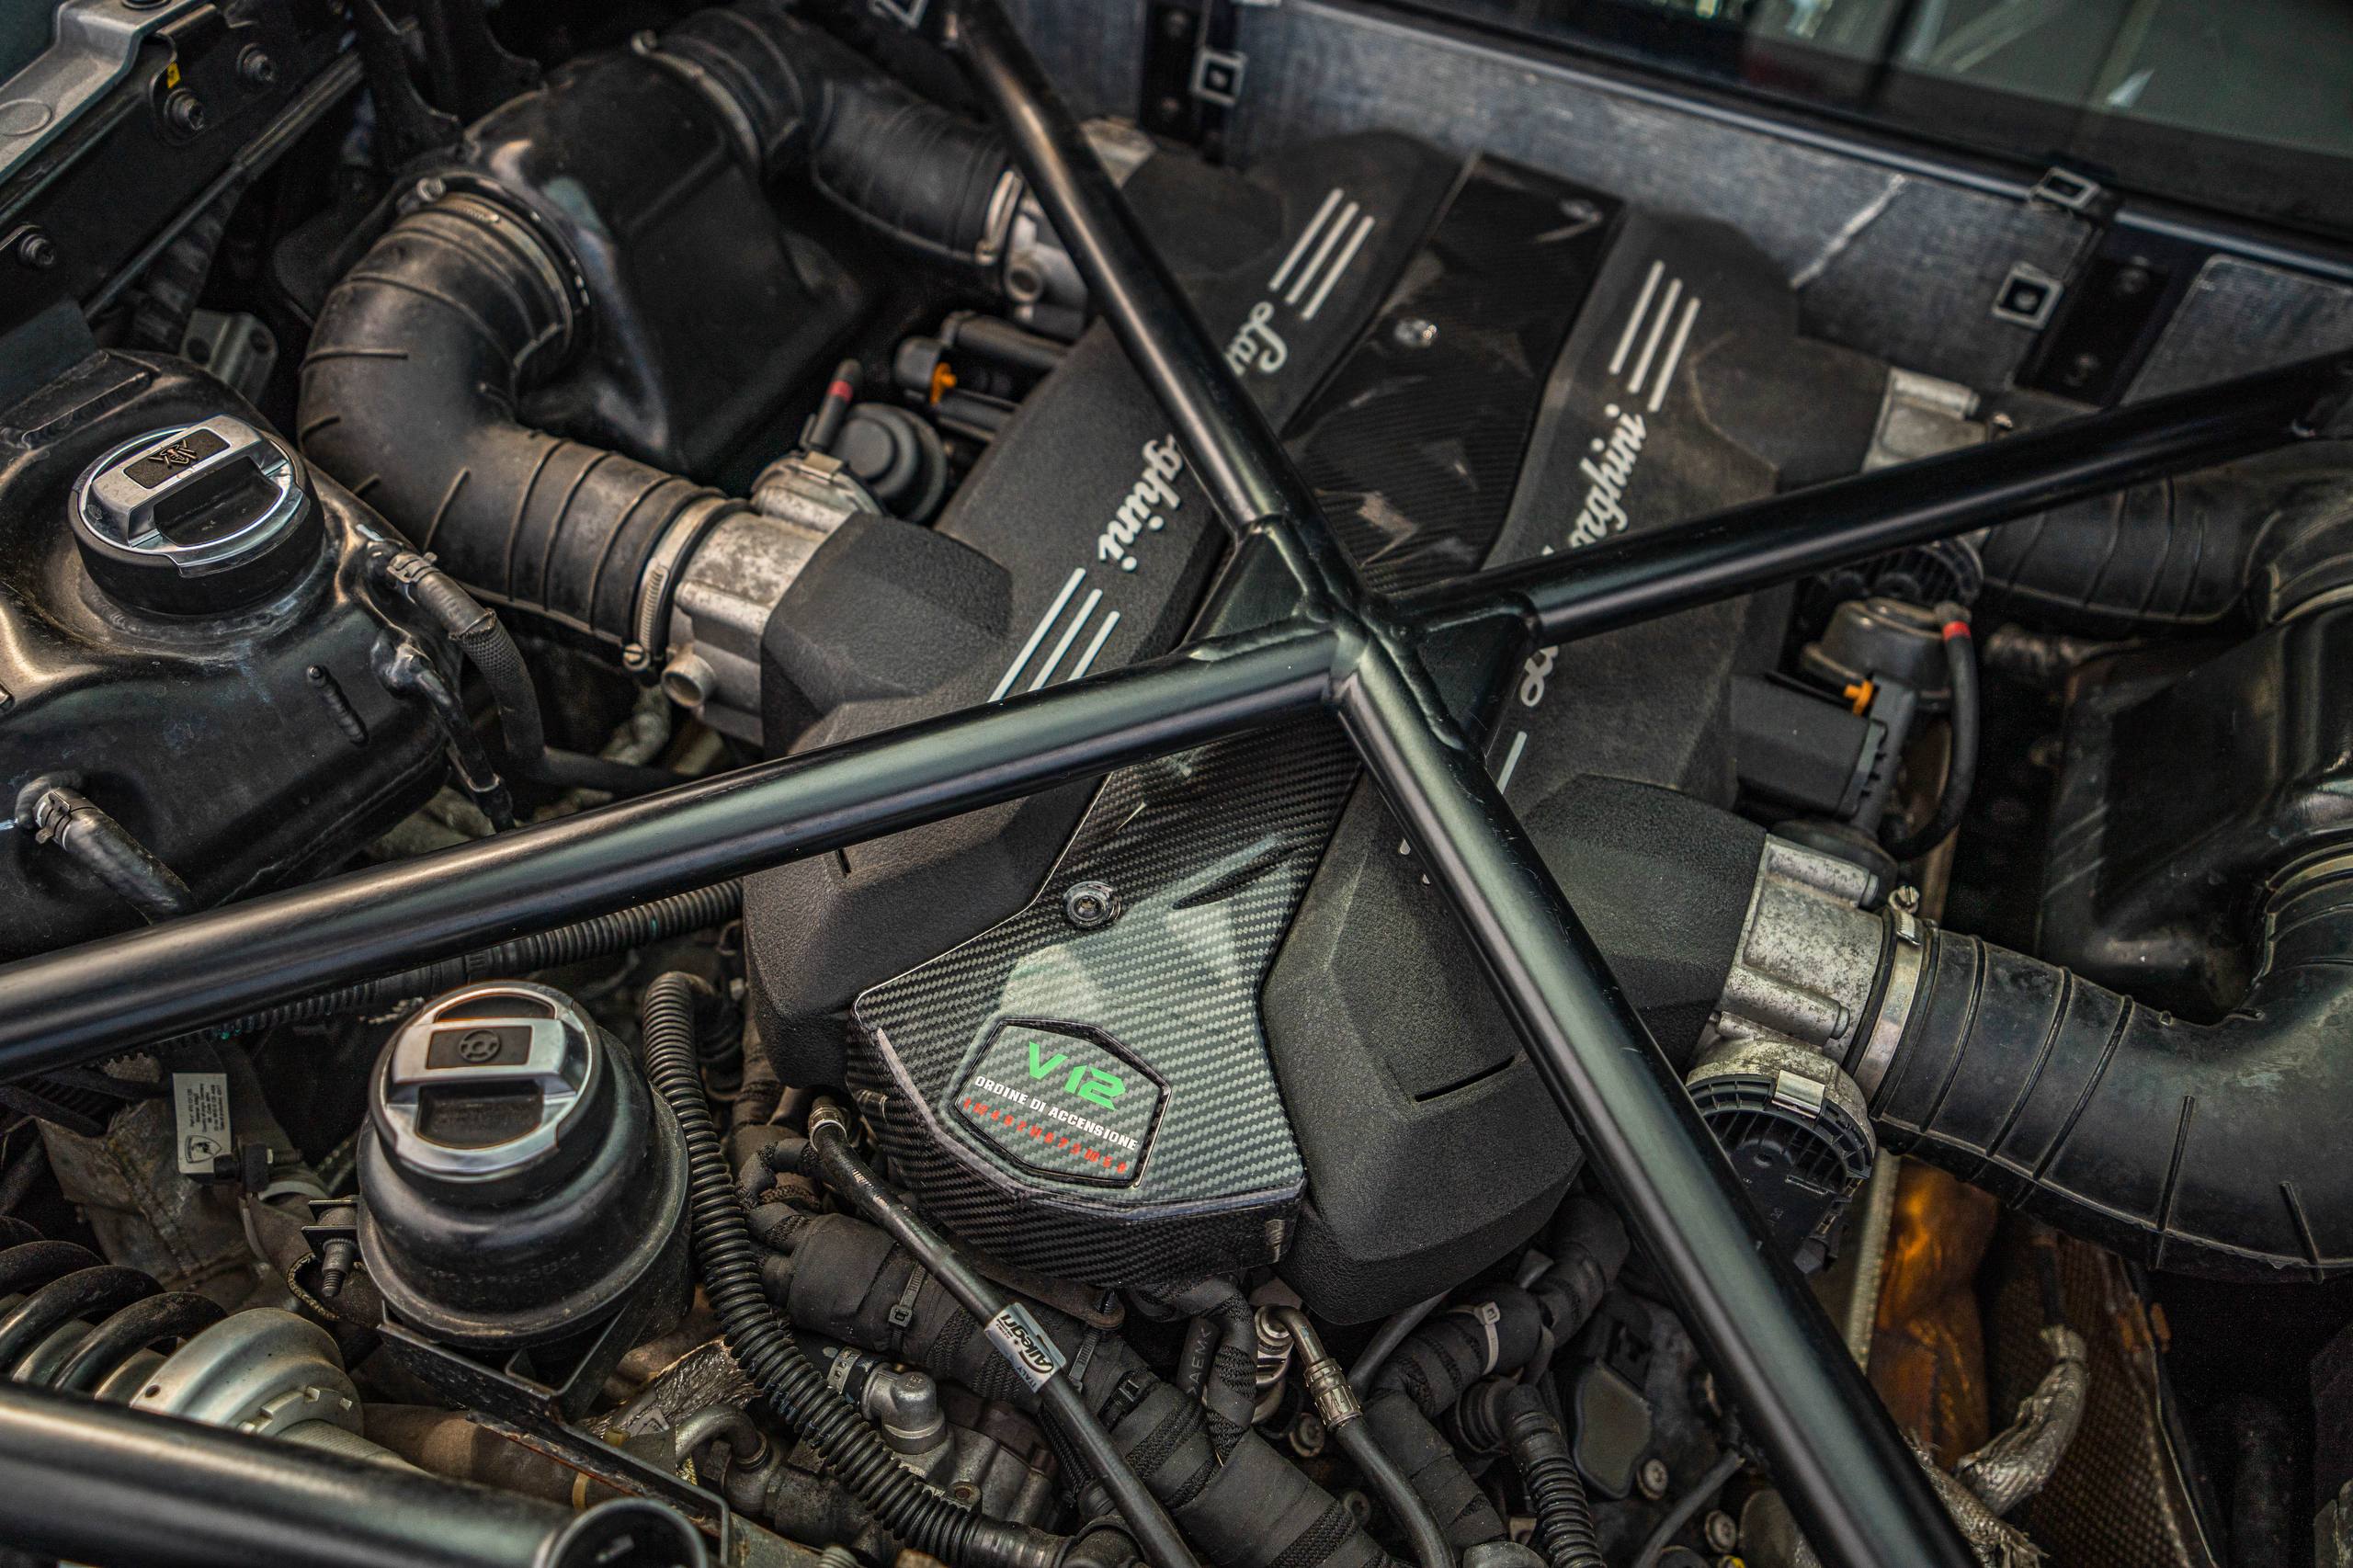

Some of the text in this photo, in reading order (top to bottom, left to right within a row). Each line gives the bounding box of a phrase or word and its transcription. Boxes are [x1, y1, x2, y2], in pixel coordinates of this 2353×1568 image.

[1029, 1041, 1126, 1111] V12
[974, 1075, 1139, 1151] ORDINE DI ACCENSIONE
[1016, 1120, 1028, 1132] 2
[1000, 1314, 1054, 1367] Allegri
[1017, 1367, 1037, 1388] ITALY
